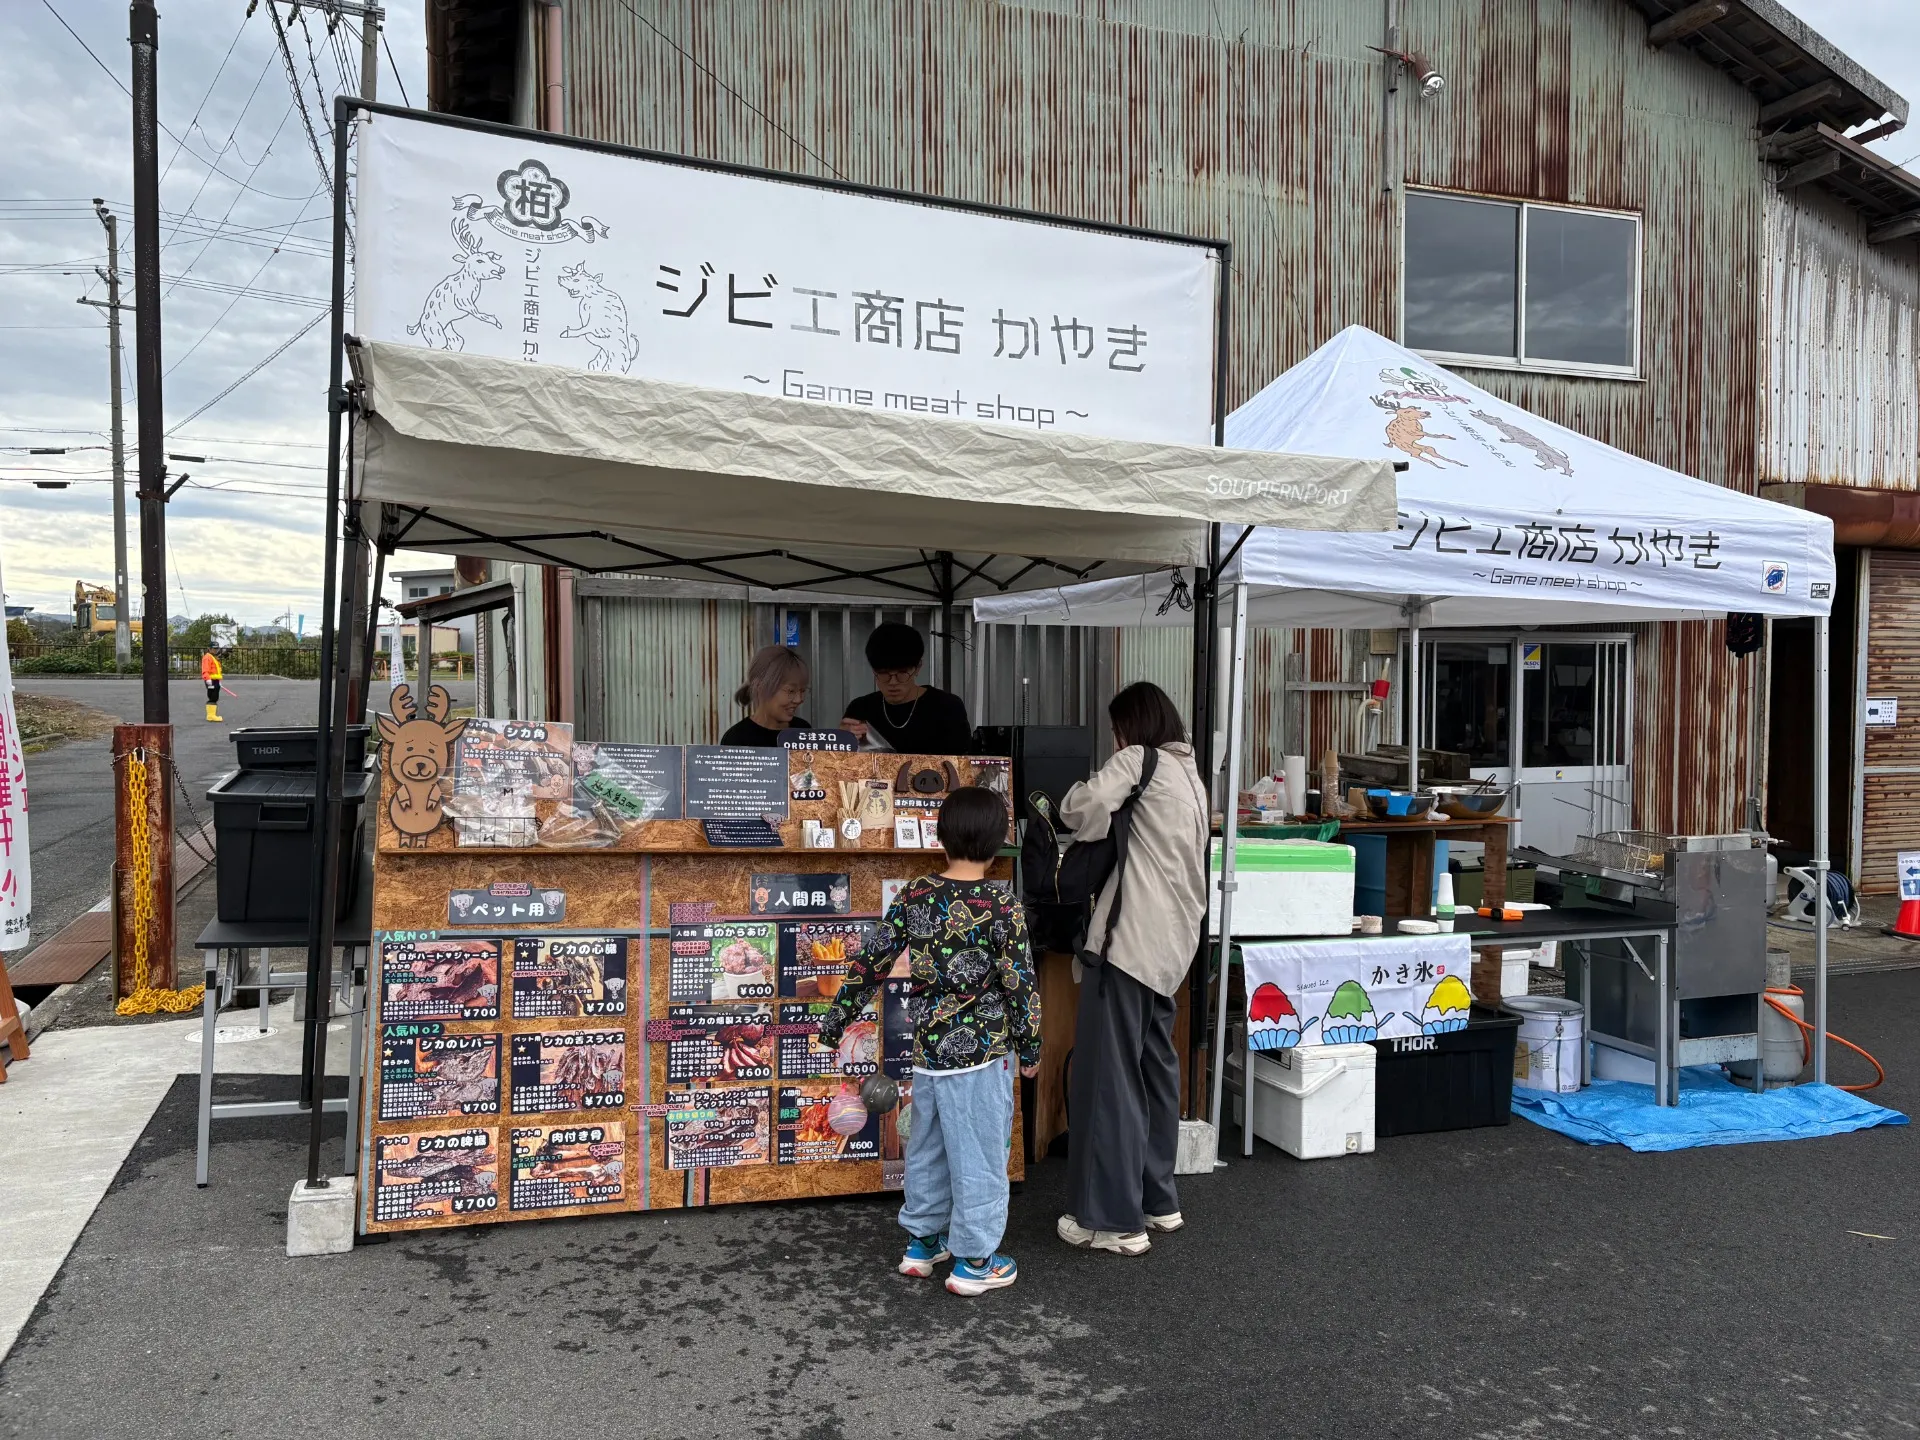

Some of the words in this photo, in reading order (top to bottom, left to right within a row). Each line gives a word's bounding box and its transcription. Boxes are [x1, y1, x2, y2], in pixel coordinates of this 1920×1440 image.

[494, 218, 518, 236] Game
[520, 231, 545, 241] meat
[546, 230, 569, 242] shop
[655, 261, 965, 357] ジビエ商店
[992, 307, 1148, 374] かやき
[782, 368, 873, 409] Game
[884, 389, 968, 417] meat
[976, 393, 1056, 431] shop
[1205, 474, 1352, 505] SOUTHERNPORT
[1607, 526, 1722, 570] かやき
[1490, 567, 1537, 587] Game
[1587, 574, 1628, 594] shop
[507, 727, 545, 740] シカ角
[798, 732, 837, 742] ご注文口
[783, 742, 819, 750] ORDER
[825, 743, 852, 751] HERE
[792, 790, 824, 799] ¥400
[774, 890, 827, 907] 人間用
[472, 903, 545, 917] ペット用
[808, 924, 871, 934] フライドポテト
[382, 930, 437, 943] 人気No1
[552, 943, 617, 955] シカの心臓
[1370, 961, 1434, 987] かき氷
[740, 986, 772, 996] ¥600
[464, 1008, 497, 1018] ¥700
[586, 1002, 625, 1013] ¥700
[689, 1015, 770, 1025] シカの燻製スライス
[383, 1024, 440, 1037] 人気No2
[384, 1038, 414, 1046] ペット用
[421, 1038, 494, 1050] シカのレバー
[544, 1034, 624, 1047] シカの舌スライス
[1391, 1036, 1439, 1053] THOR.
[737, 1068, 770, 1078] ¥600
[845, 1064, 876, 1074] ¥600
[695, 1090, 768, 1101] シカ・イノシシの燻製
[781, 1089, 801, 1097] 人間用
[585, 1095, 624, 1106] ¥700
[695, 1099, 747, 1108] テイクアウト用
[463, 1102, 497, 1113] ¥700
[668, 1111, 715, 1120] お持ち帰り用
[780, 1108, 800, 1119] 限定
[671, 1122, 684, 1130] シカ
[512, 1129, 541, 1137] ペット用
[551, 1129, 602, 1144] 肉付き骨
[379, 1137, 409, 1145] ペット用
[420, 1135, 487, 1150] シカの脾臓
[670, 1135, 698, 1143] イノシシ
[849, 1141, 873, 1150] ¥600
[588, 1185, 620, 1195] ¥1000
[454, 1197, 496, 1210] ¥700
